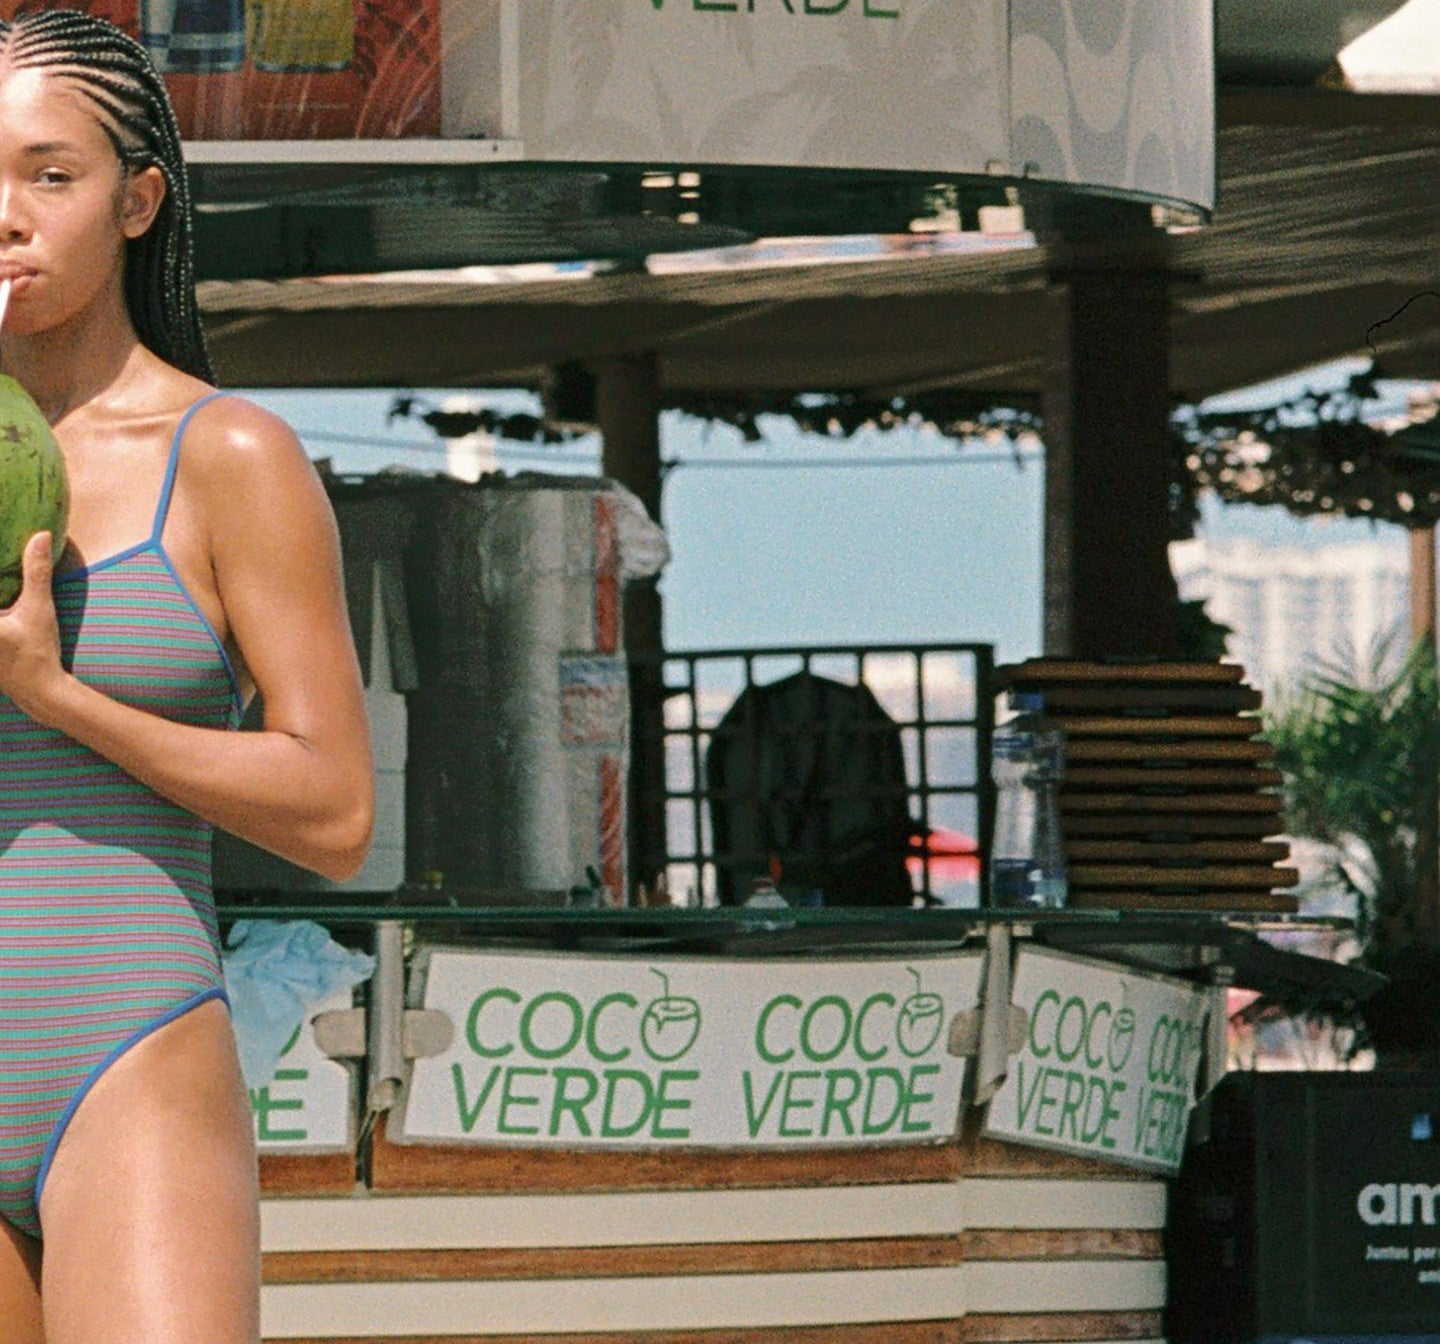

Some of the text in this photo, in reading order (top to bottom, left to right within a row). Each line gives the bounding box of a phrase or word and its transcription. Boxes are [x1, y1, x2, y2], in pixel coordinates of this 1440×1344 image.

[452, 1063, 941, 1139] VERDE VERDE
[1016, 1060, 1127, 1148] VERDE
